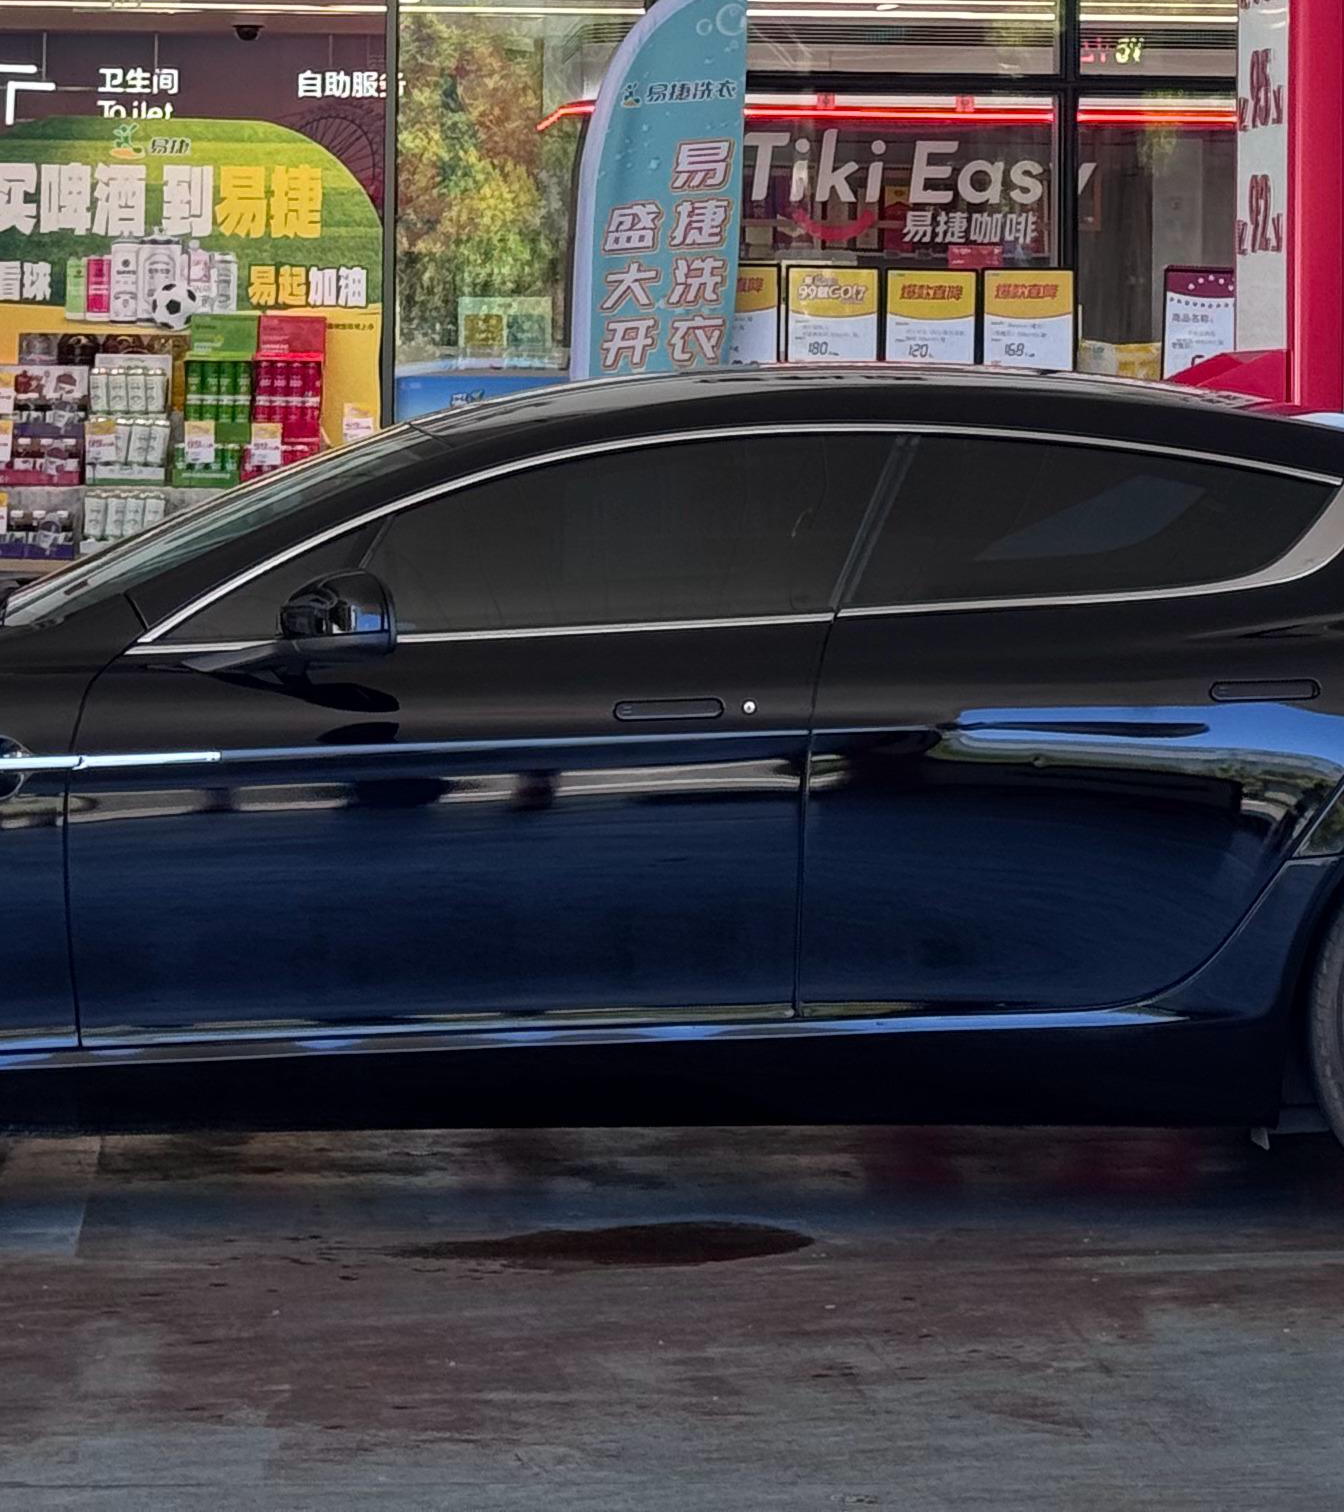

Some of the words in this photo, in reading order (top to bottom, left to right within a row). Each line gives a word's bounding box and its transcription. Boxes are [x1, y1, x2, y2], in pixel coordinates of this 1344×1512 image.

[97, 67, 180, 95] 卫生间
[96, 100, 175, 120] Toilet
[743, 128, 886, 203] Tiki
[162, 163, 324, 239] 到易捷
[901, 209, 1039, 245] 易捷咖啡
[669, 138, 735, 365] 易捷洗衣
[248, 264, 368, 308] 易起加油
